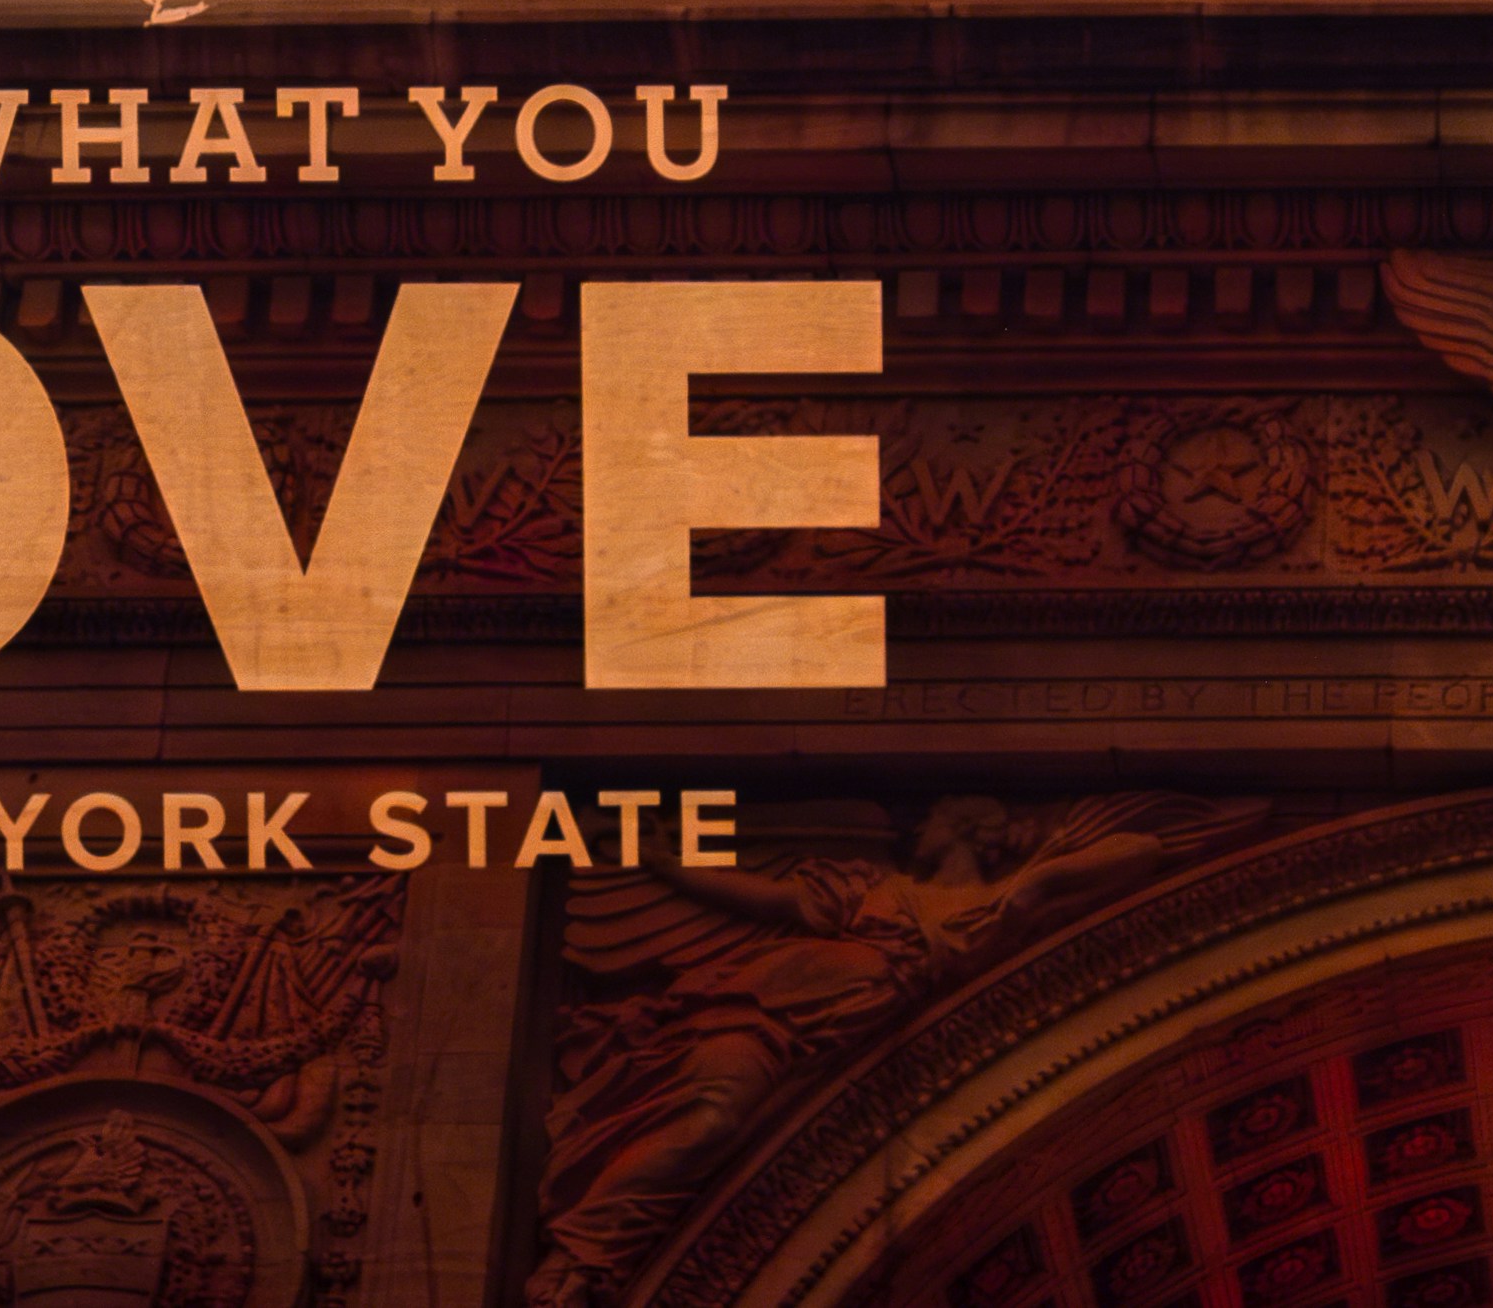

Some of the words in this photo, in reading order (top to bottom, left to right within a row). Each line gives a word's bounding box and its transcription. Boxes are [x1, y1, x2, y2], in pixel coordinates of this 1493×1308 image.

[408, 83, 728, 182] YOU
[843, 684, 1112, 715] ERECTED
[1140, 684, 1204, 711] BY
[1240, 682, 1350, 712] THE
[368, 788, 738, 872] STATE
